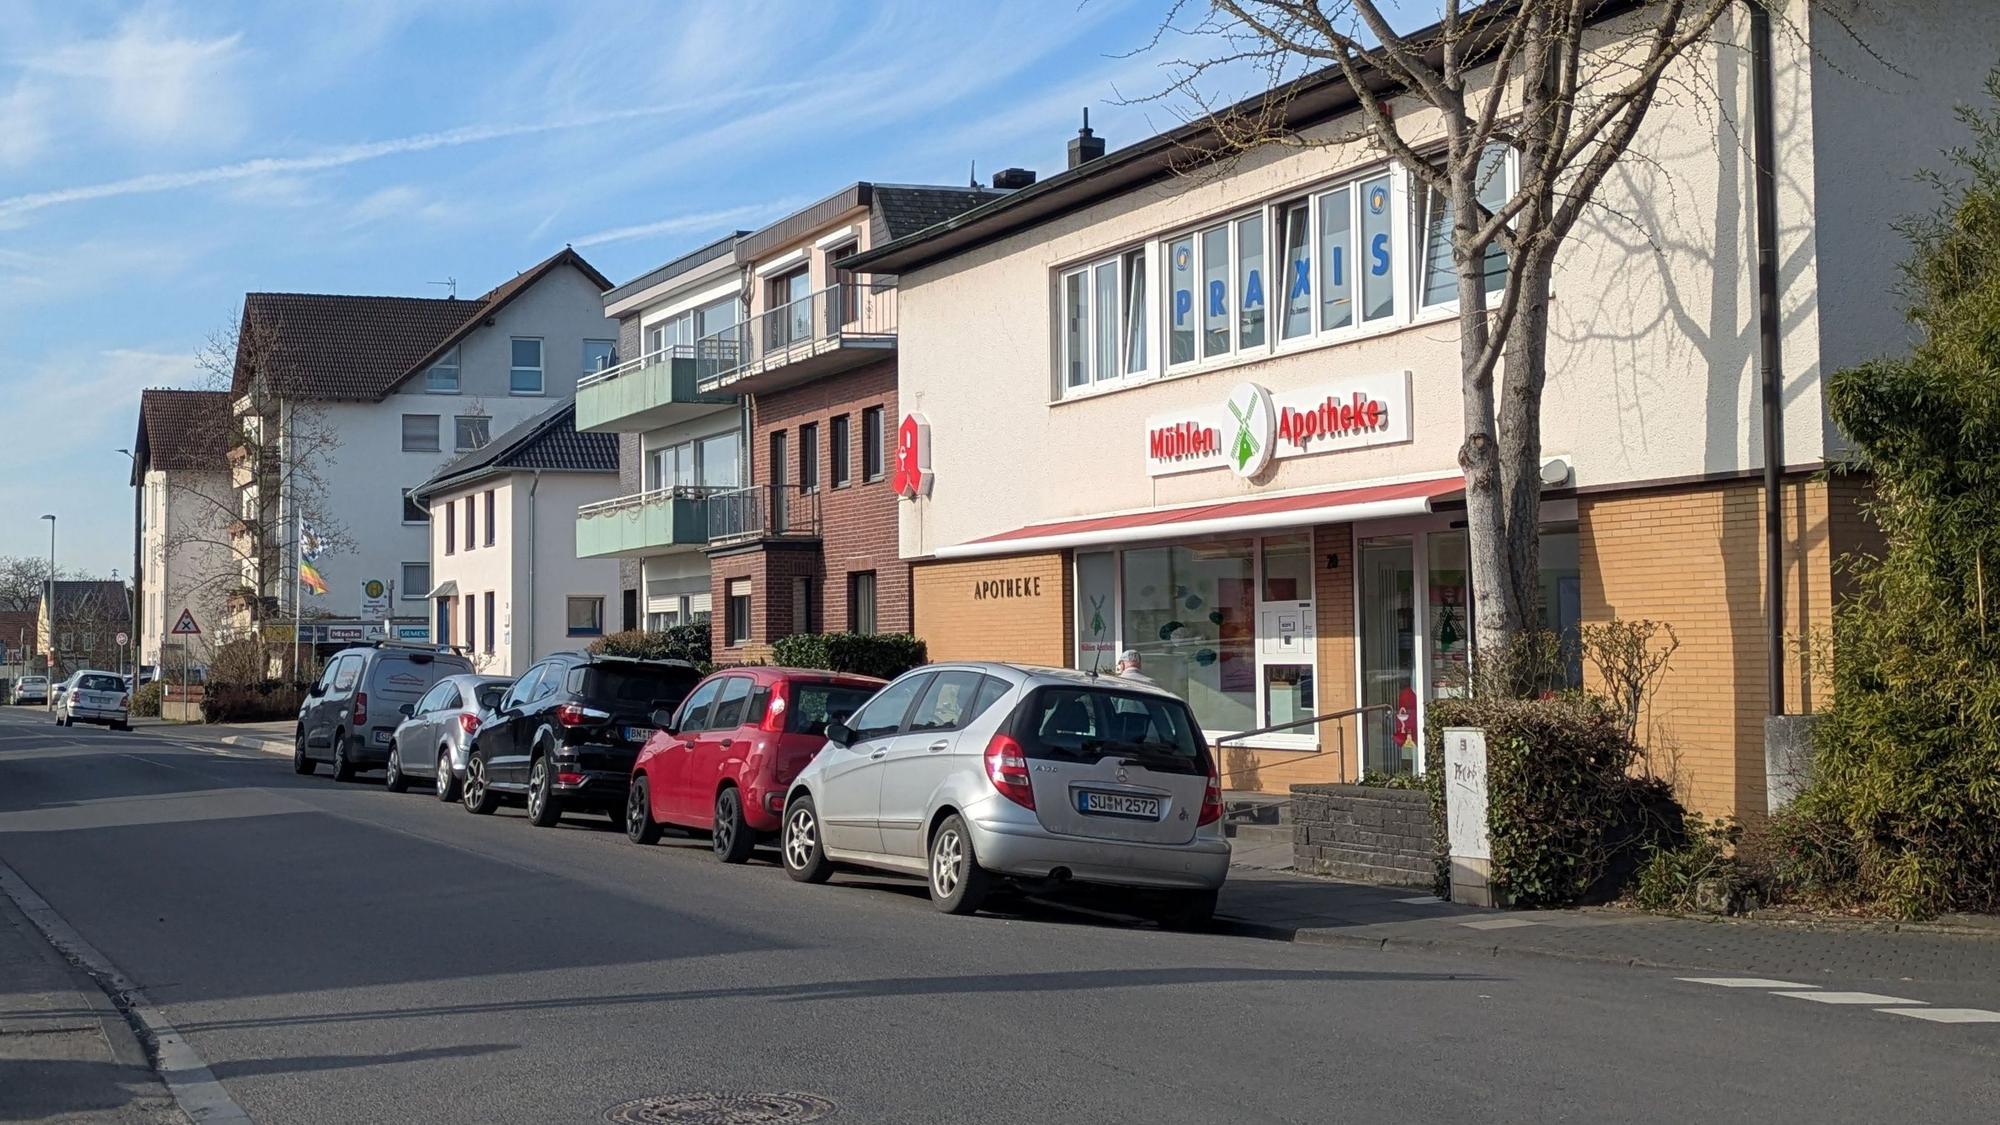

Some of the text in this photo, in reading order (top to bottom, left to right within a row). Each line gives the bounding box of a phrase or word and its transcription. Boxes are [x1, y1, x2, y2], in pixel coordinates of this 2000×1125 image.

[1176, 233, 1390, 326] PRAXIS
[1150, 391, 1381, 459] Mühlen Apotheke
[974, 576, 1041, 600] APOTHEKE
[331, 630, 361, 638] Miele
[631, 728, 642, 738] BN
[1089, 795, 1157, 814] SU M 2572
